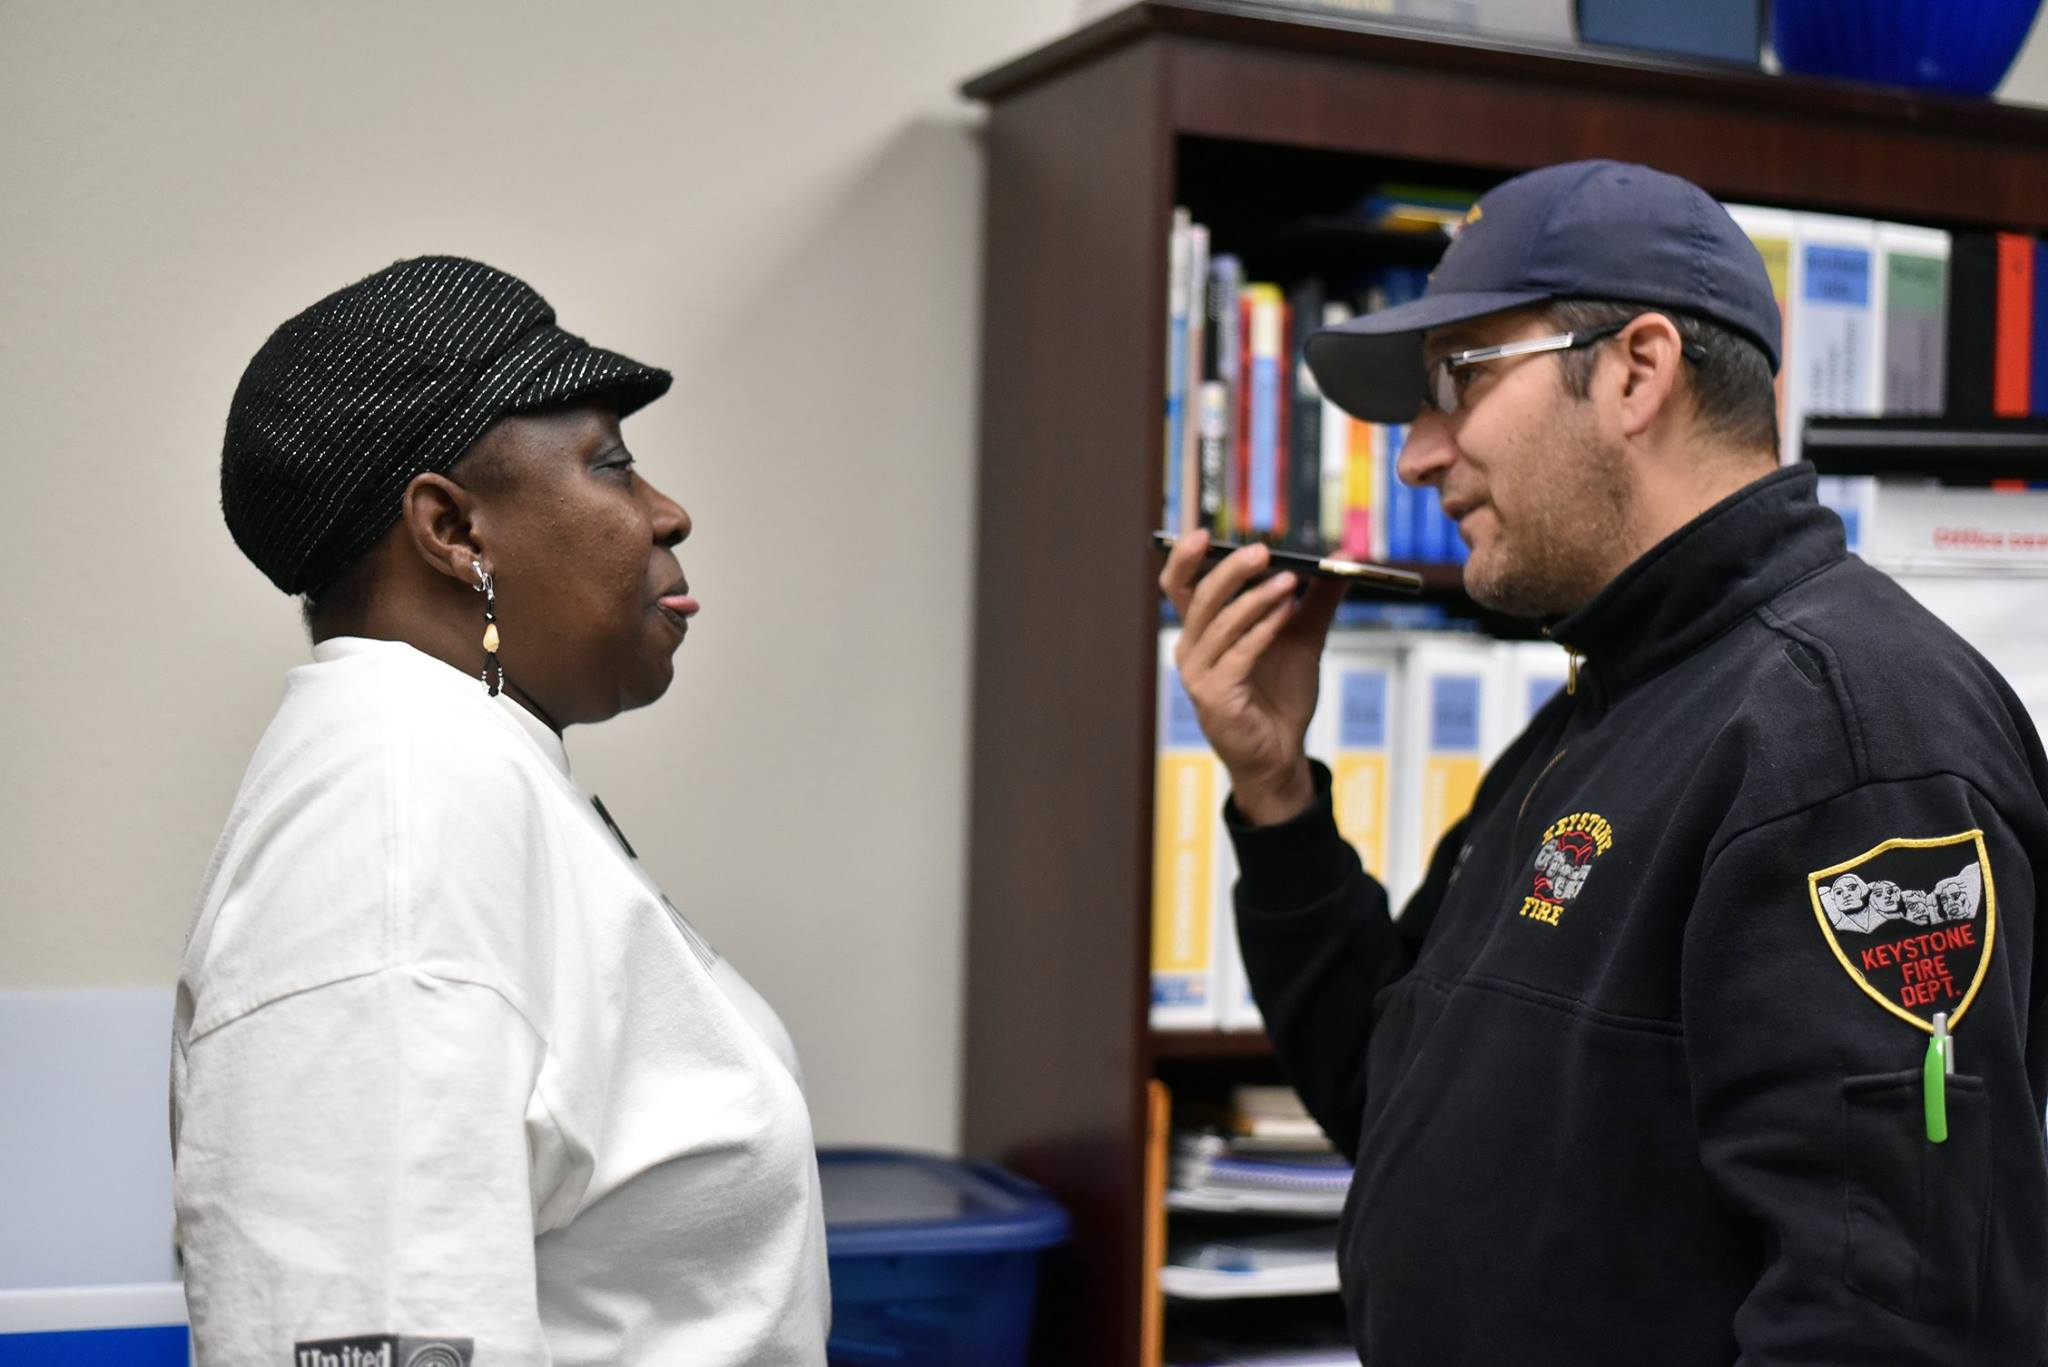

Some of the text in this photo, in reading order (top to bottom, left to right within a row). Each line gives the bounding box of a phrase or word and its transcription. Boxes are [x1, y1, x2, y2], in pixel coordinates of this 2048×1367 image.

[1543, 813, 1612, 855] KEYSTONE
[1520, 897, 1564, 926] FIRE
[1862, 925, 1975, 970] KEYSTONE
[1902, 956, 1947, 983] FIRE
[1901, 978, 1961, 1007] DEPT.
[299, 1341, 392, 1367] United
